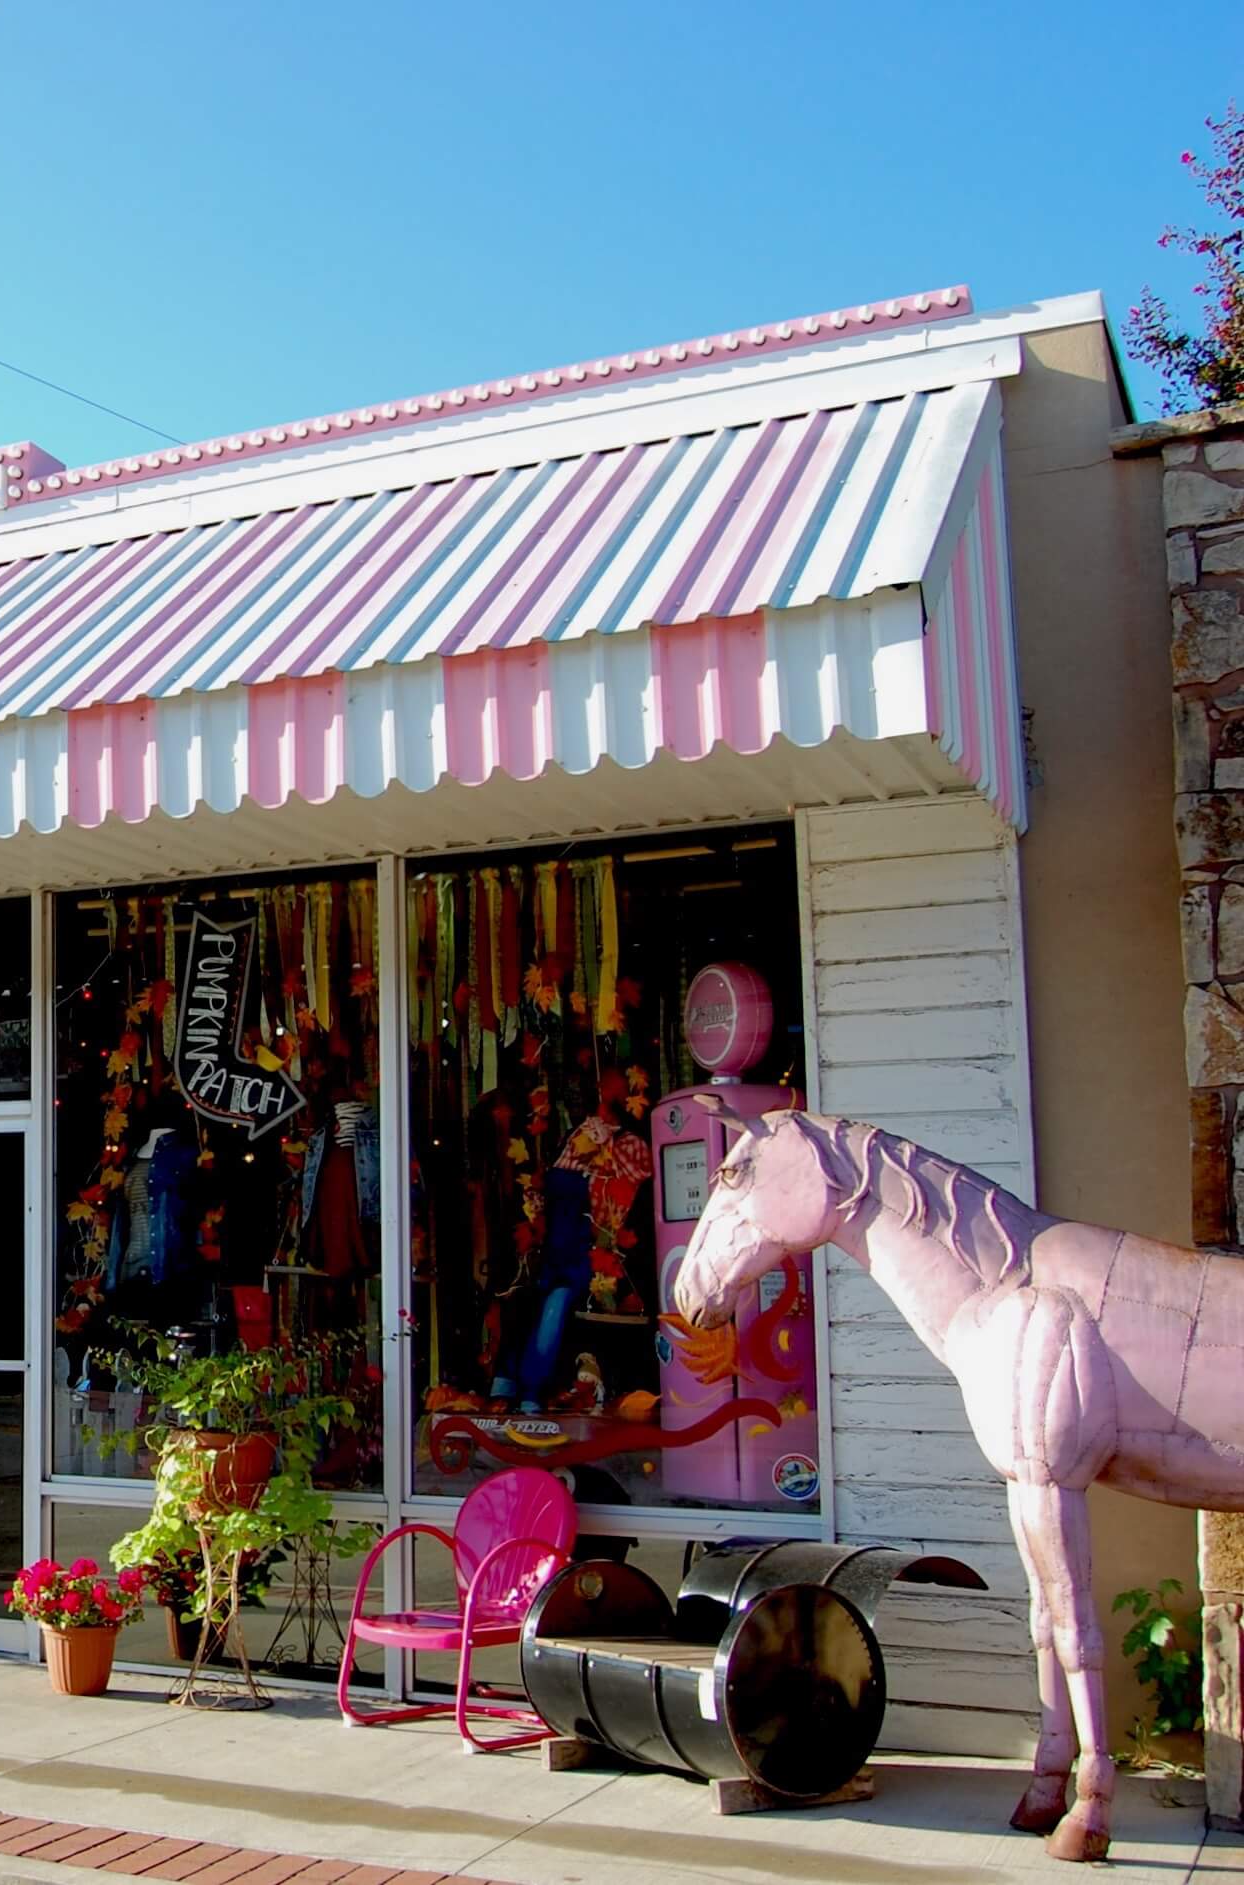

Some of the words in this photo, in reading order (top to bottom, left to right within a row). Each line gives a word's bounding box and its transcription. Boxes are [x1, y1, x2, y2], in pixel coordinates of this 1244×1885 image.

[185, 933, 237, 1061] PUMPKIN
[187, 1059, 286, 1115] PATCH
[515, 1422, 560, 1434] FLYER
